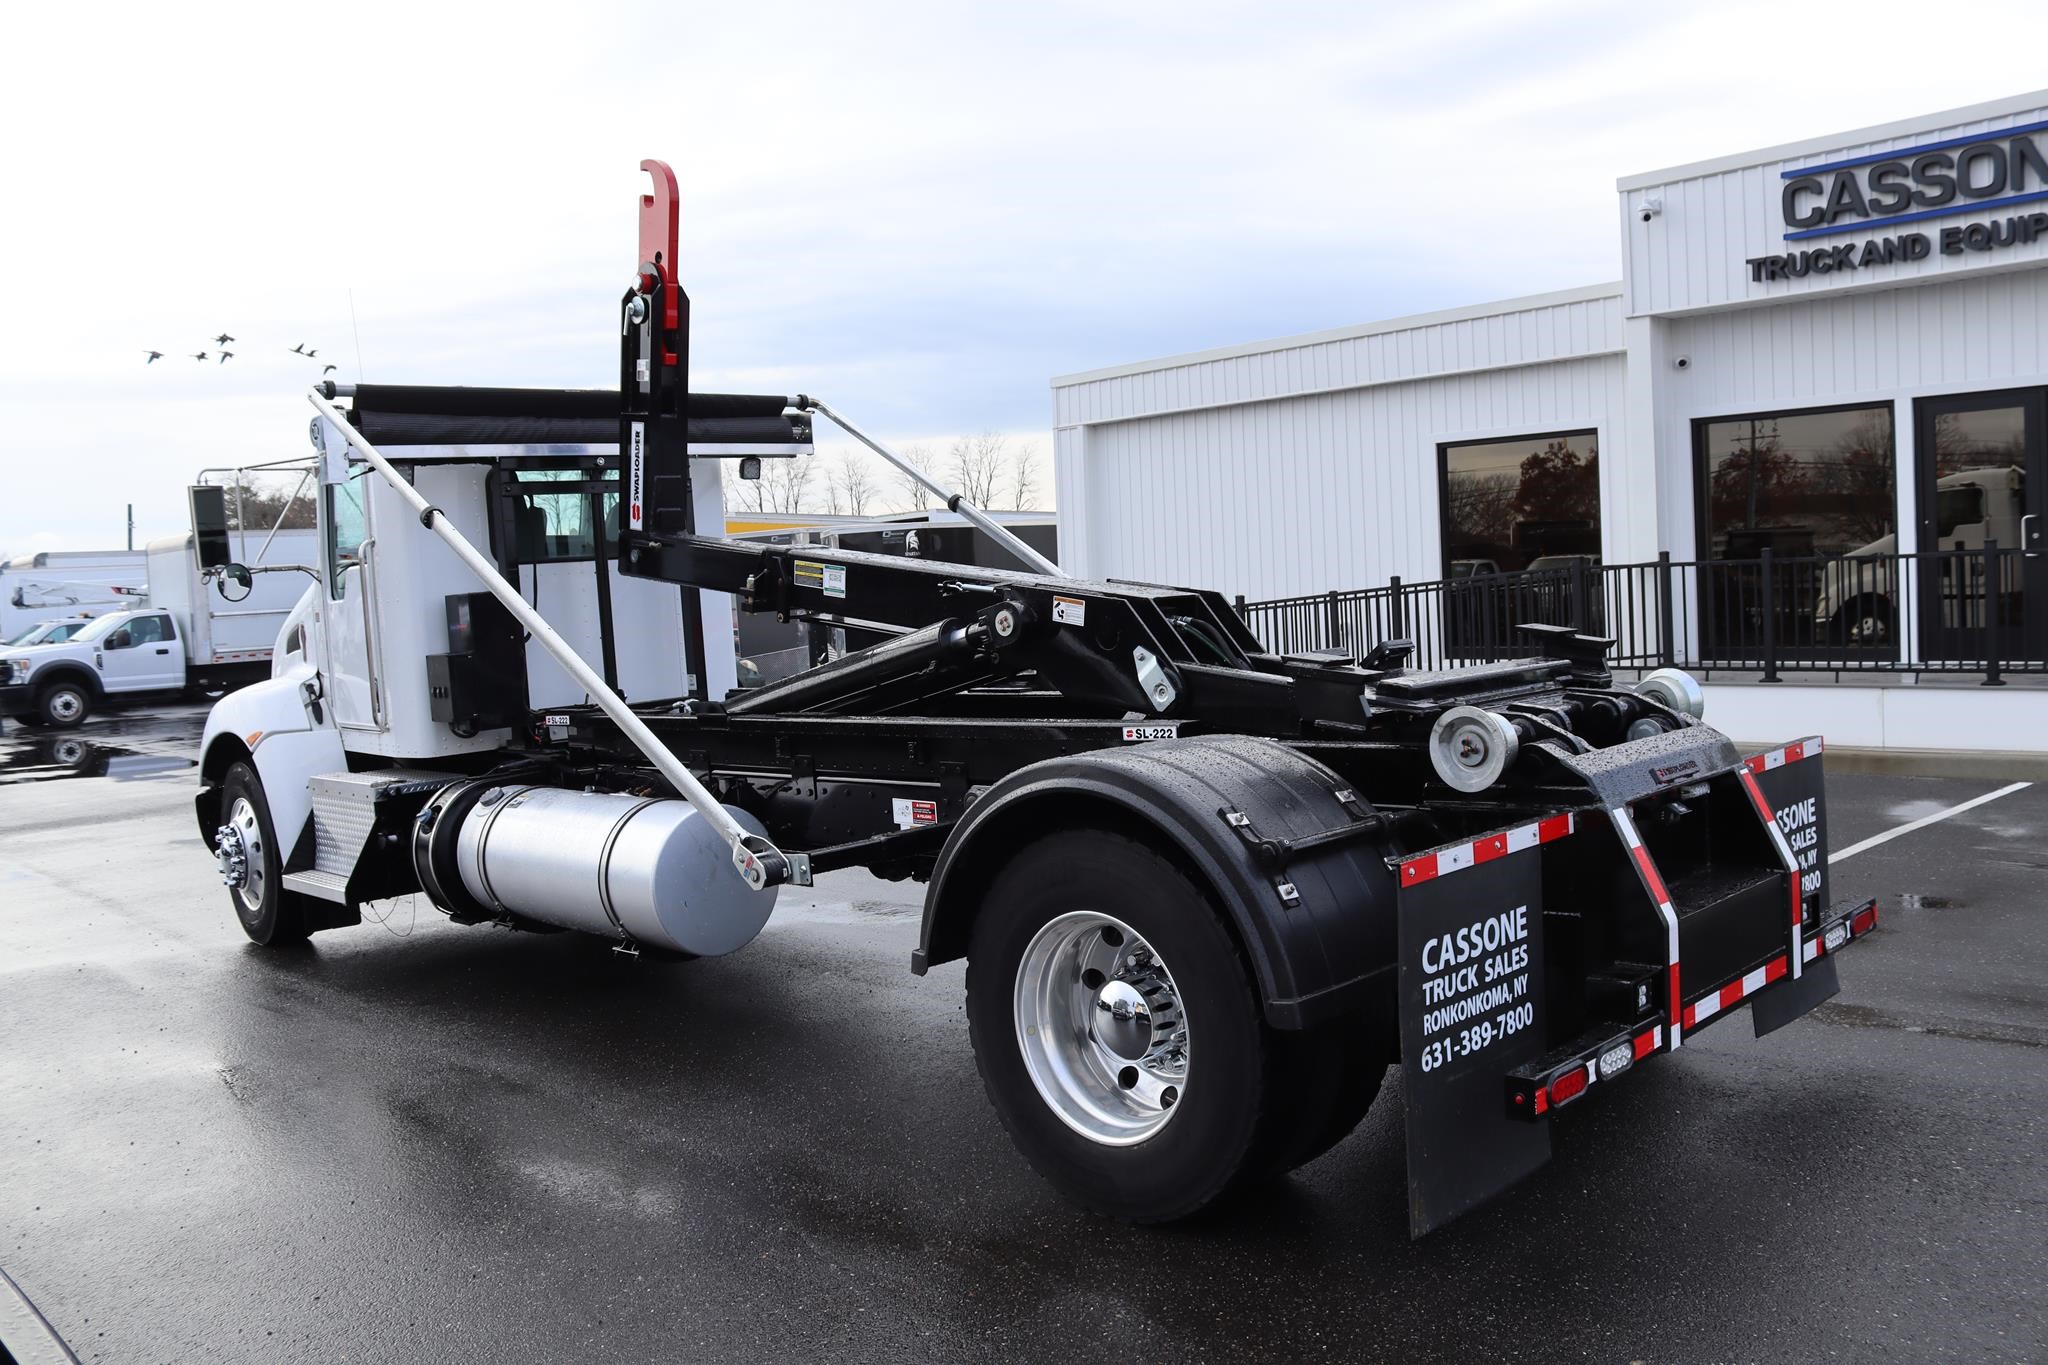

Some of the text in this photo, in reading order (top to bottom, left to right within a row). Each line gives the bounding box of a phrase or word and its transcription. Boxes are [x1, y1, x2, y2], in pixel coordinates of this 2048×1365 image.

[1782, 136, 2048, 228] CASSON
[1746, 212, 2048, 282] TRUCK AND EQUIP
[633, 430, 641, 502] SWAPLOADER
[551, 716, 568, 724] SL-222
[1135, 728, 1173, 739] SL-222
[1776, 797, 1816, 834] SSONE
[1791, 826, 1817, 852] SALES
[1807, 848, 1817, 866] NY
[1422, 905, 1528, 974] CASSONE
[1422, 944, 1529, 1006] TRUCK SALES
[1423, 974, 1528, 1036] RONKONKOMA, NY
[1421, 1002, 1533, 1072] 631-389-7800
